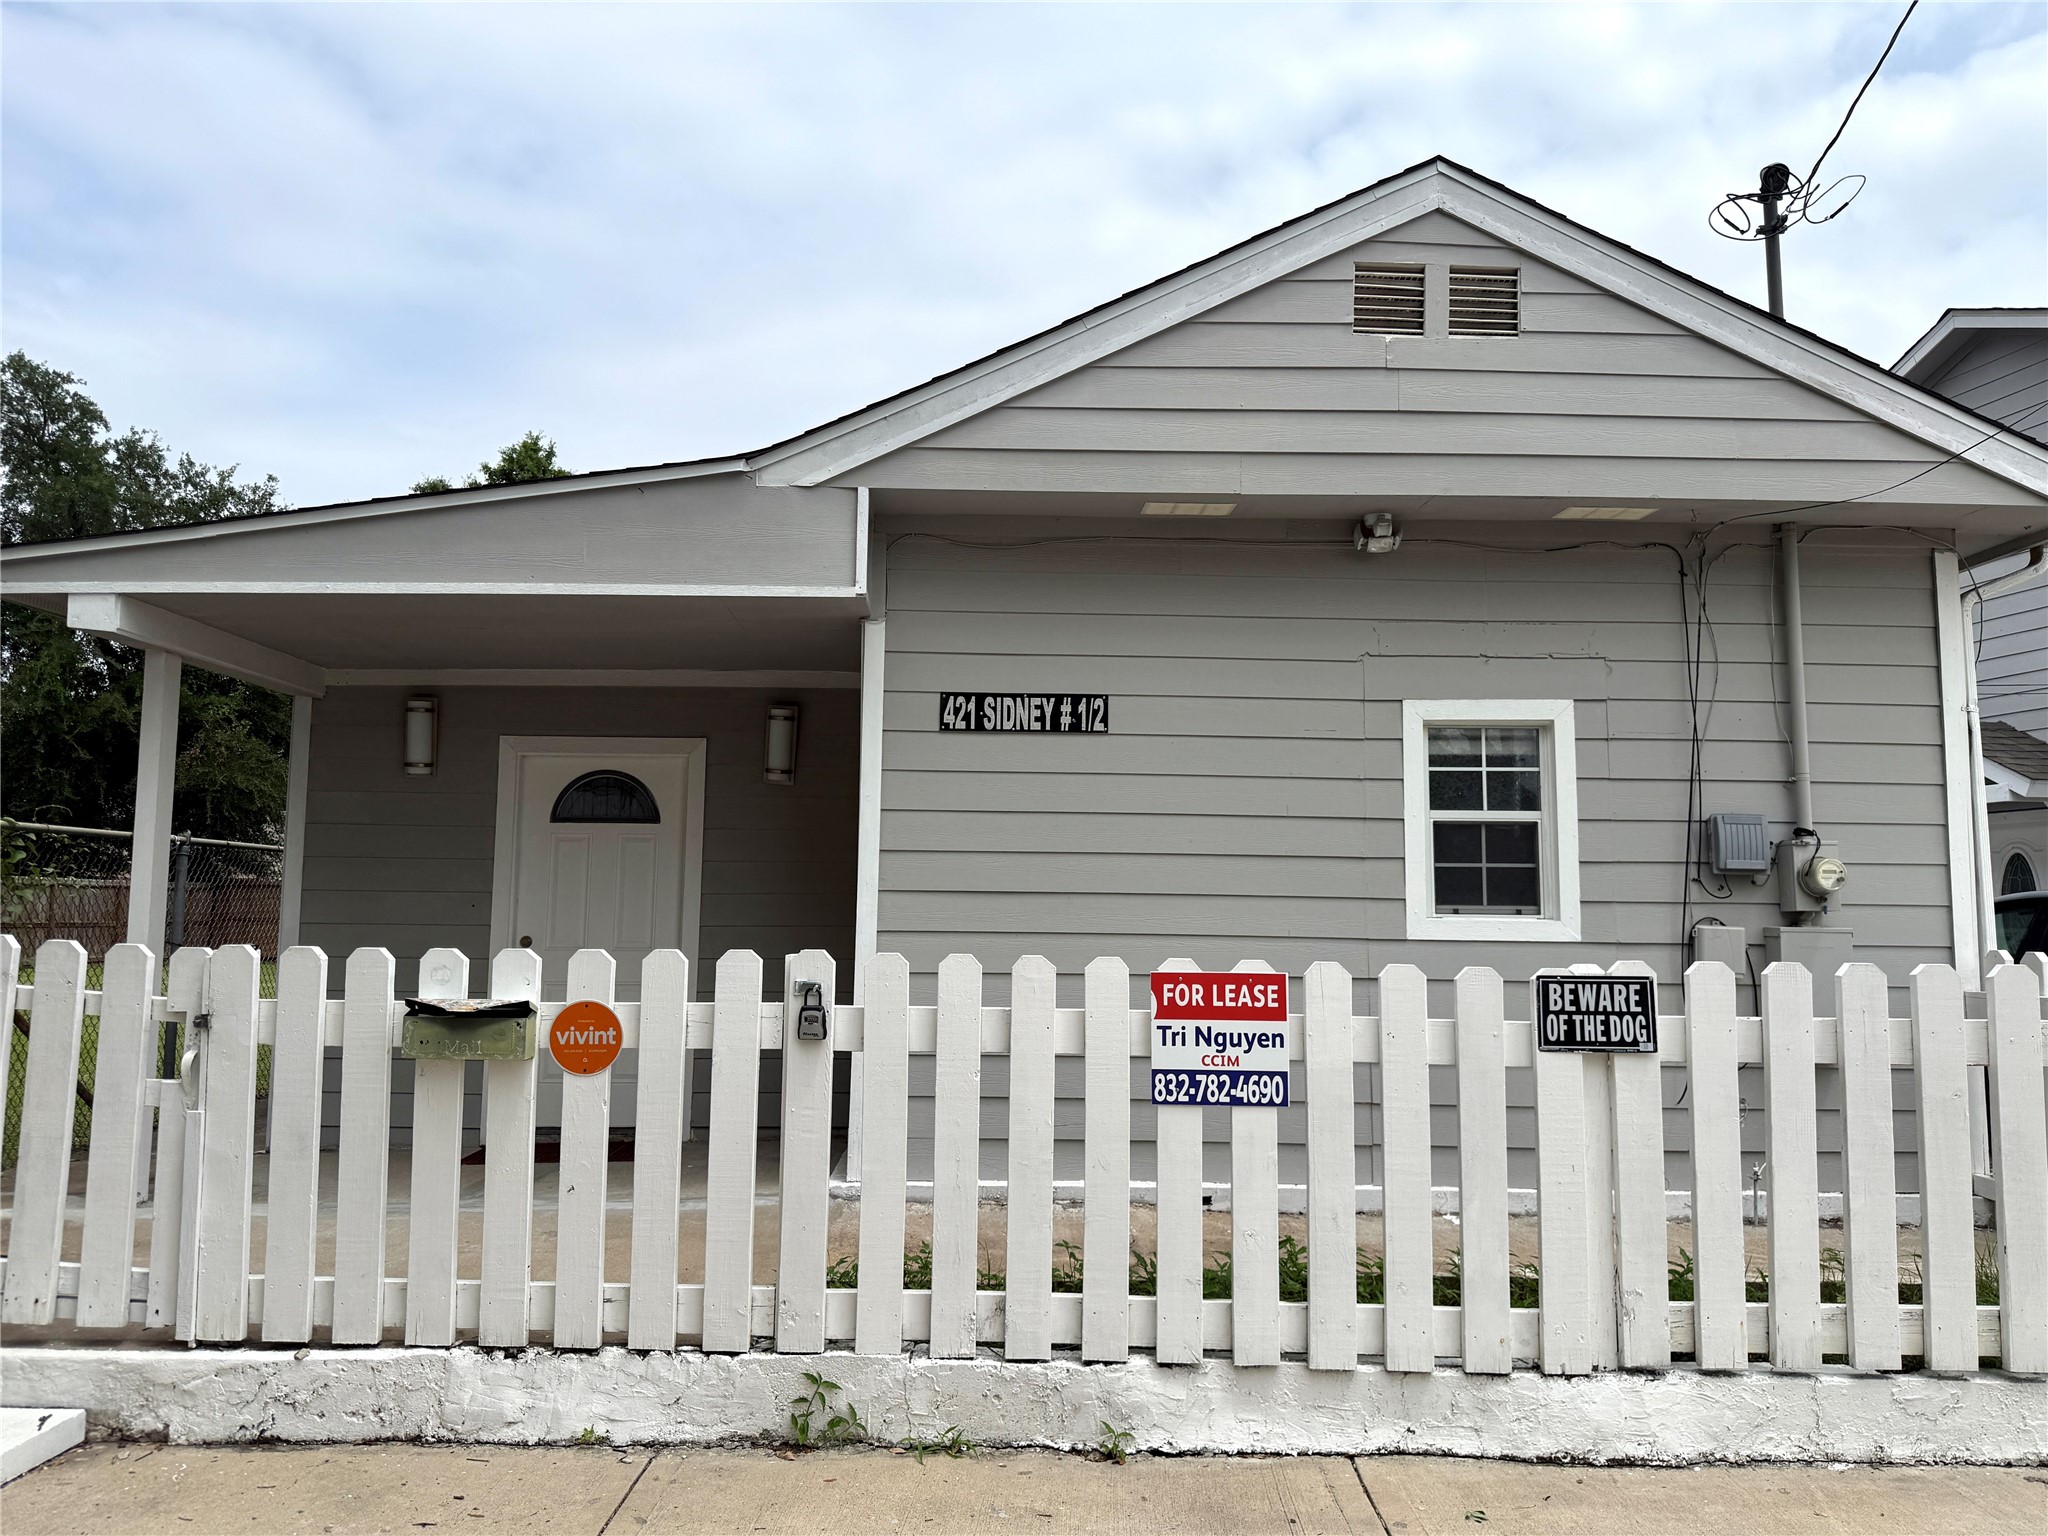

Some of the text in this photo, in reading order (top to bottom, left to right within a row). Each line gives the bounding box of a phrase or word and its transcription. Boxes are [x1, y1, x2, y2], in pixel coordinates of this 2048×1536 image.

[943, 696, 1105, 732] 421 SIDNEY # 1/2
[1163, 983, 1279, 1008] FOR LEASE
[1548, 983, 1642, 1012] BEWARE
[555, 1025, 617, 1045] vivint
[1156, 1025, 1285, 1054] Tri Nguyen
[1546, 1013, 1647, 1043] OF THE DOG
[444, 1039, 483, 1055] Mail
[1201, 1054, 1240, 1067] CCIM
[1154, 1073, 1284, 1104] 832-782-4690
